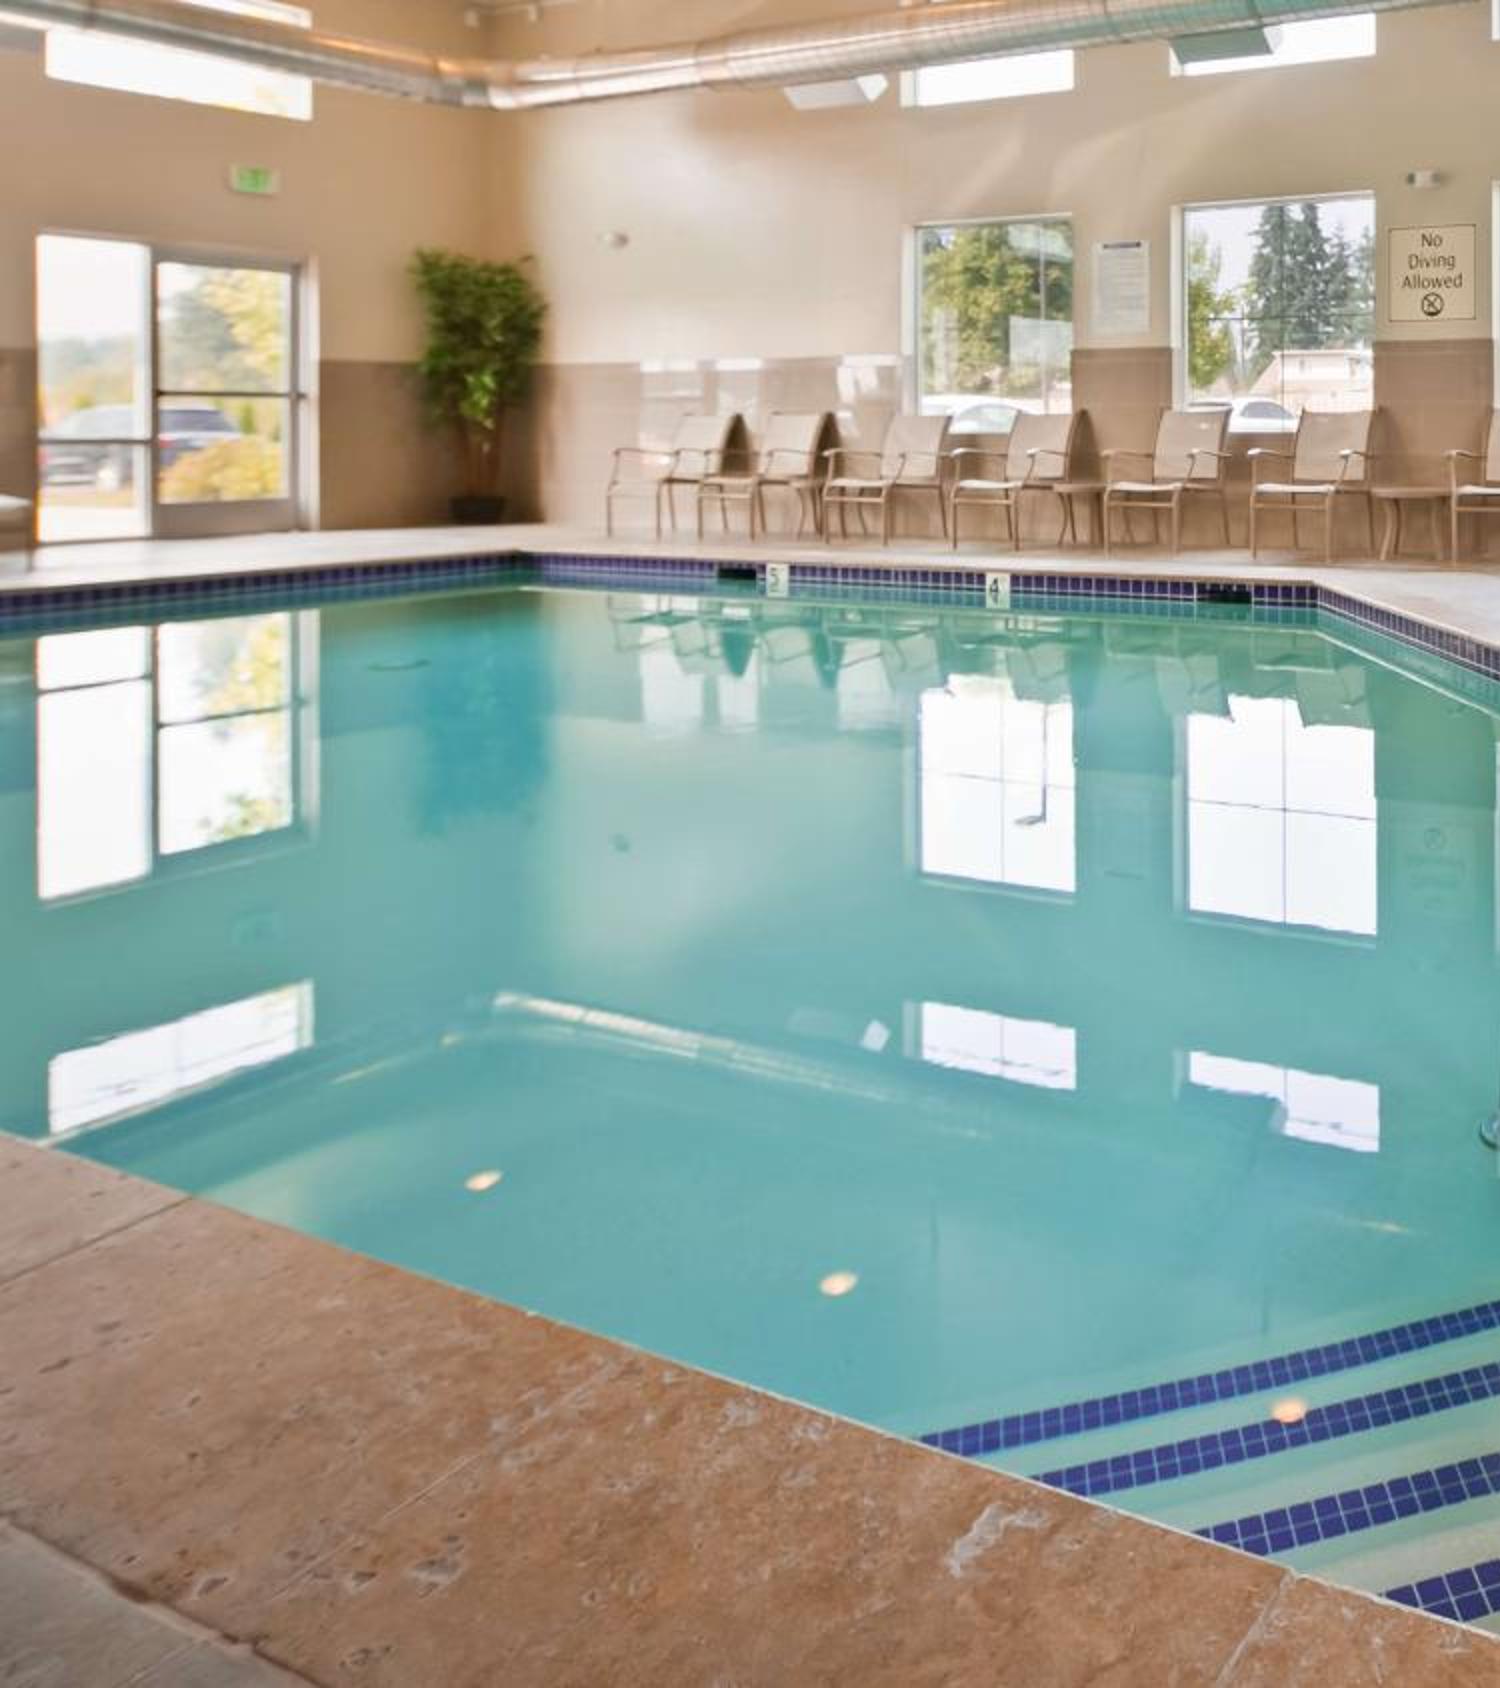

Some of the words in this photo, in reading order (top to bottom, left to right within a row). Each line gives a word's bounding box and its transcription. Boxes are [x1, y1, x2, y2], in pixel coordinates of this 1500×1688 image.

[1421, 232, 1443, 248] No
[1408, 254, 1455, 270] Diving
[1401, 273, 1463, 289] Allowed
